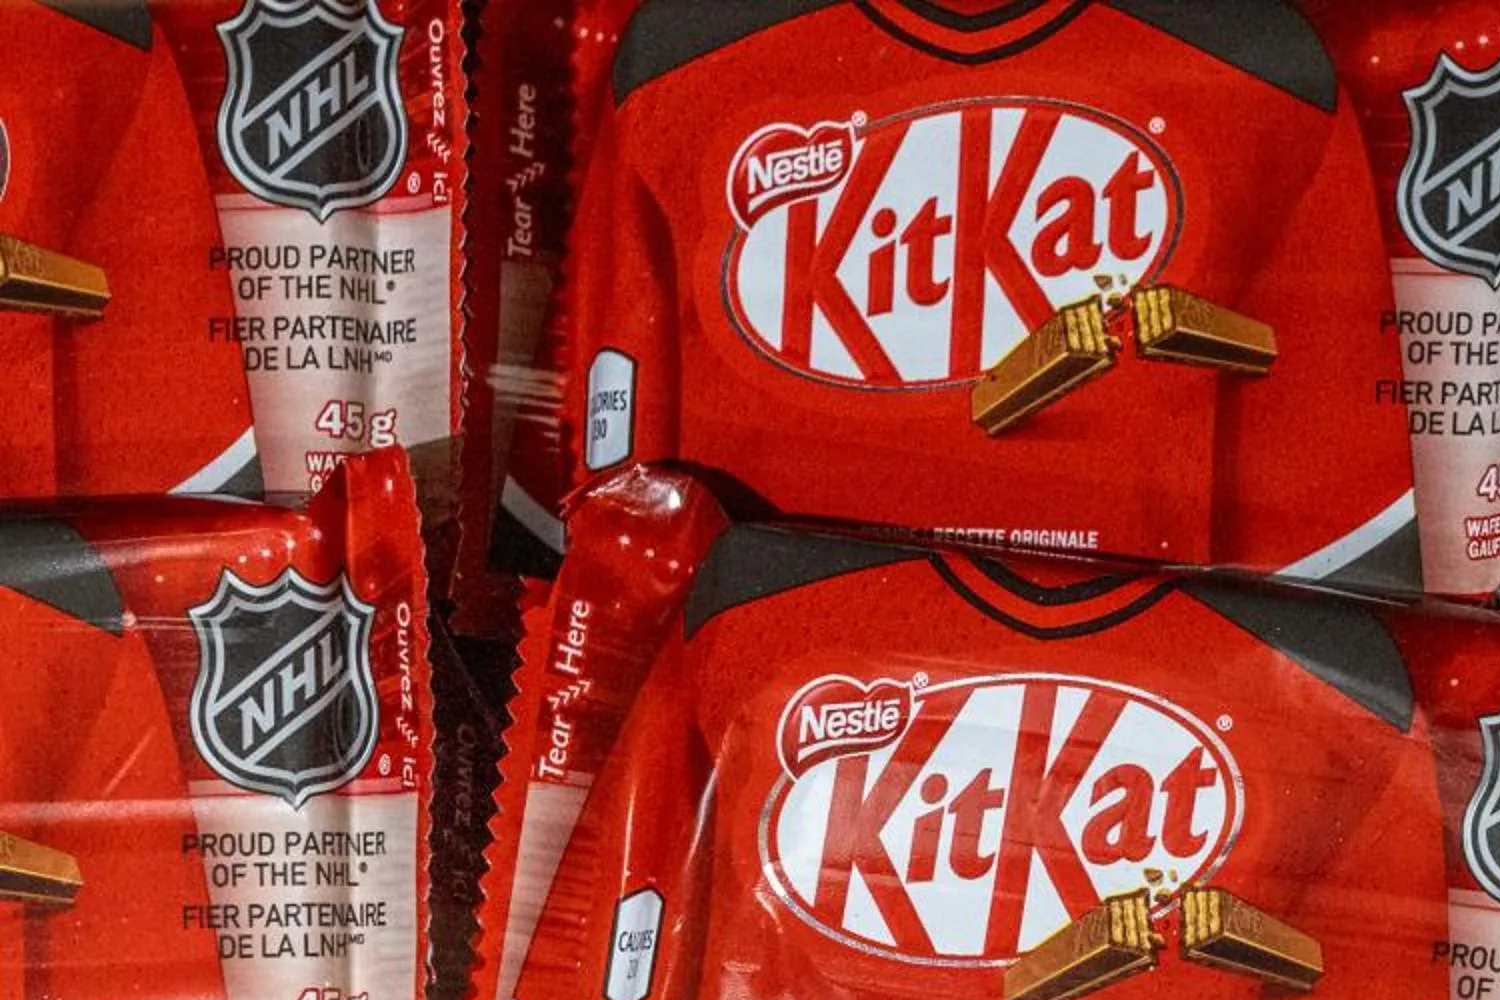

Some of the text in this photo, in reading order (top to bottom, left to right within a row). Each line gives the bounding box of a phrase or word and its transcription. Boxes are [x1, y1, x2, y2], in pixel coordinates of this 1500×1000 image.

[427, 18, 448, 127] Ouvrez
[265, 52, 370, 166] NHL
[507, 83, 537, 258] Tear Here
[780, 105, 1155, 384] KitKat
[208, 245, 416, 274] PROUD PARTNER
[238, 275, 331, 301] OF THE
[208, 316, 417, 345] FIER PARTENAIRE
[1380, 311, 1473, 336] PROUD
[244, 347, 320, 372] DE LA
[1407, 341, 1498, 366] OF THE
[1376, 380, 1433, 405] FIER
[314, 400, 365, 438] 45
[1410, 411, 1485, 435] DE LA
[1010, 528, 1098, 549] ORIGINALE
[396, 601, 415, 718] Ouvrez
[238, 631, 344, 751] NHL
[538, 600, 592, 780] Tear Here
[813, 685, 1218, 956] KitKat
[182, 831, 387, 858] PROUD PARTNER
[211, 862, 307, 888] OF THE
[183, 901, 388, 930] FIER PARTENAIRE
[220, 934, 294, 960] DE LA
[1457, 975, 1494, 1000] OF
